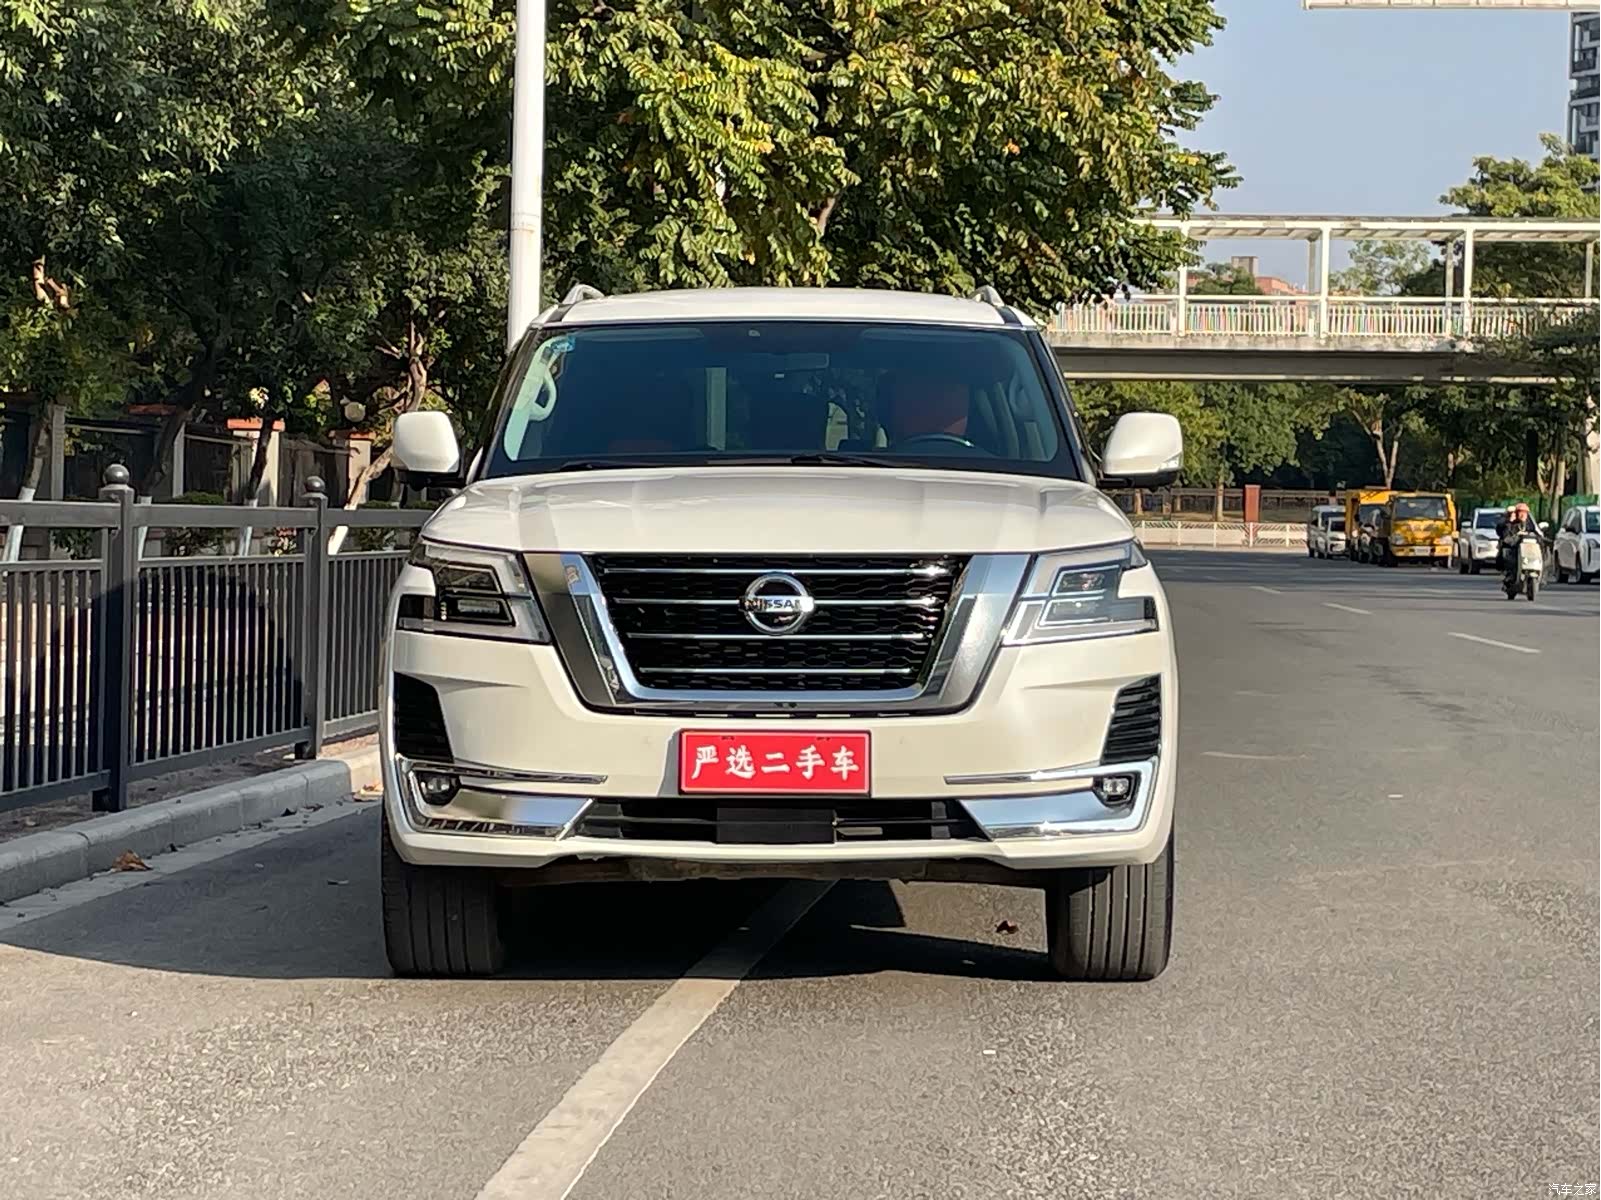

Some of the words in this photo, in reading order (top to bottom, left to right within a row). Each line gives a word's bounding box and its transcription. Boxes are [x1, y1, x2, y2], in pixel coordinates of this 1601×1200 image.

[690, 744, 860, 781] 严选二手车
